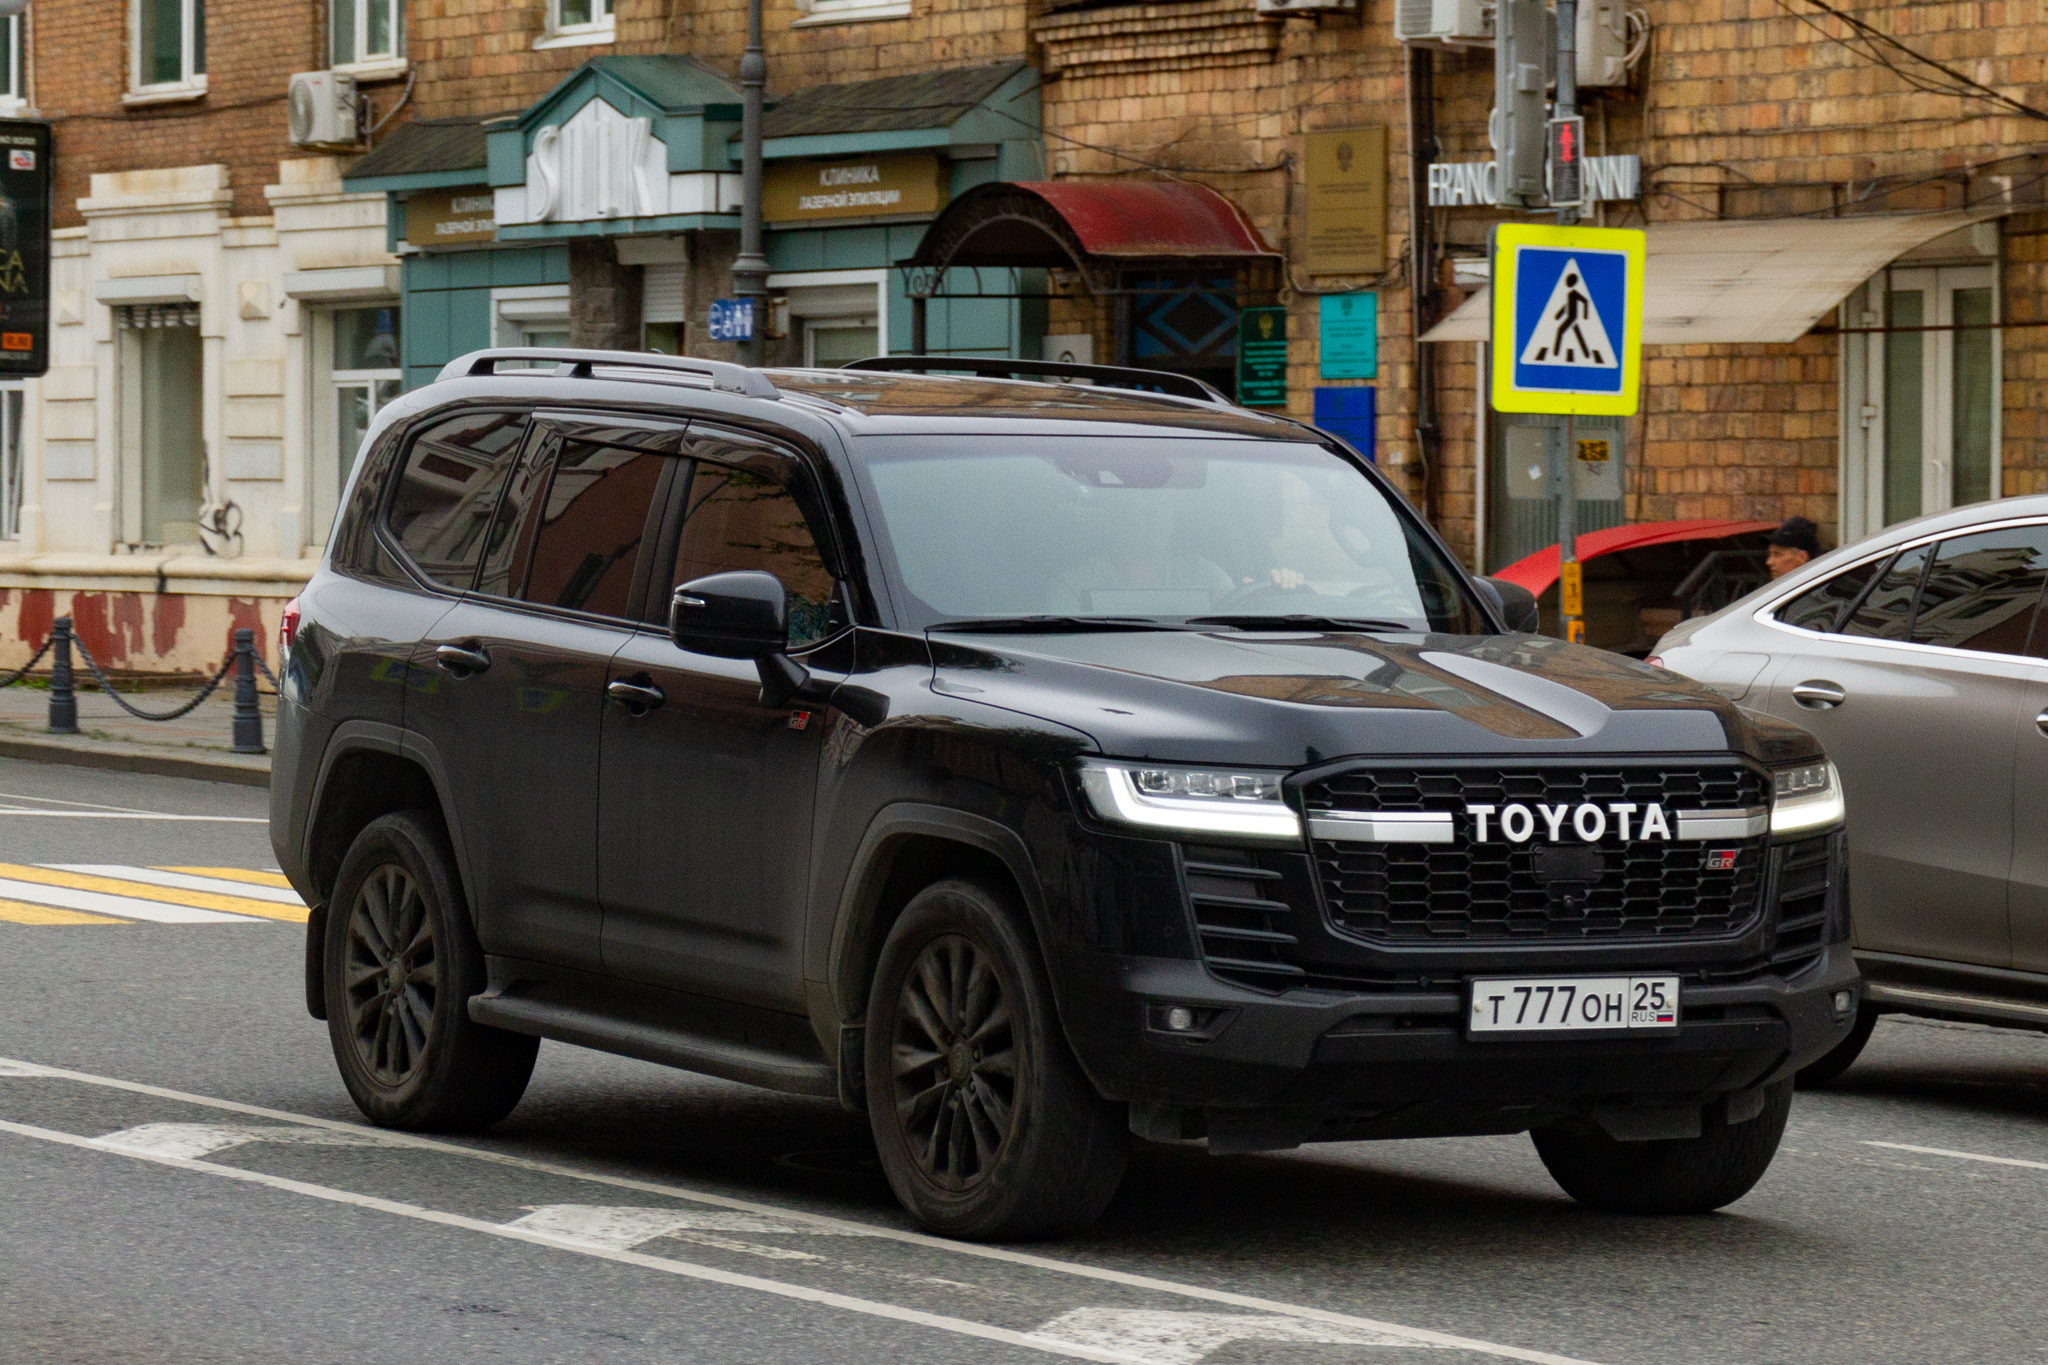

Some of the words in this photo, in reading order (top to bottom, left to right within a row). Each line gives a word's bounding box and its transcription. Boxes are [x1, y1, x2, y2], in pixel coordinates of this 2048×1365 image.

[819, 164, 881, 187] КЛИНИКА
[798, 190, 846, 210] ЛАЗЕРНОЙ
[847, 189, 901, 207] ЭПИЛЯЦИИ
[1466, 802, 1671, 843] TOYOTA
[1633, 982, 1666, 1011] 25
[1631, 1011, 1656, 1022] RUS
